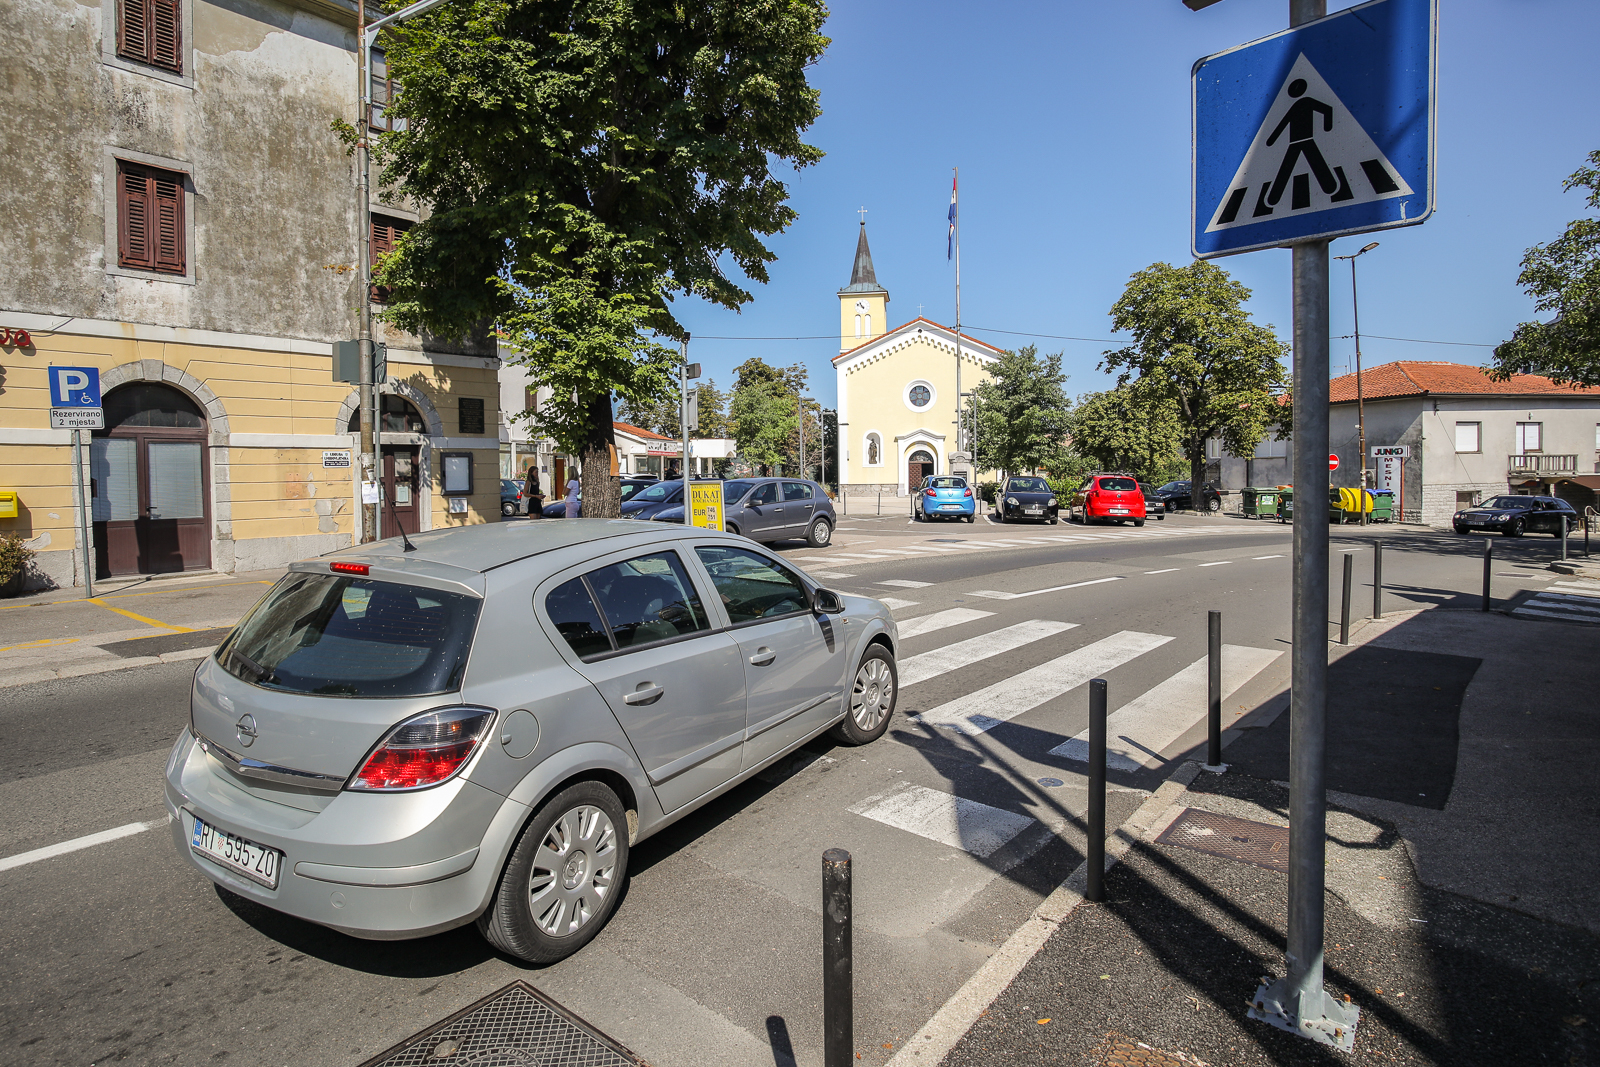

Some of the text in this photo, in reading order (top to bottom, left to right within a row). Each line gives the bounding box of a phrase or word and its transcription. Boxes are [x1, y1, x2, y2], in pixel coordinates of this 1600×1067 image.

[58, 370, 89, 401] P
[52, 410, 101, 418] Rezervirano
[59, 418, 96, 427] 2 mjesta
[692, 490, 719, 499] DUKAT
[201, 822, 215, 849] RI
